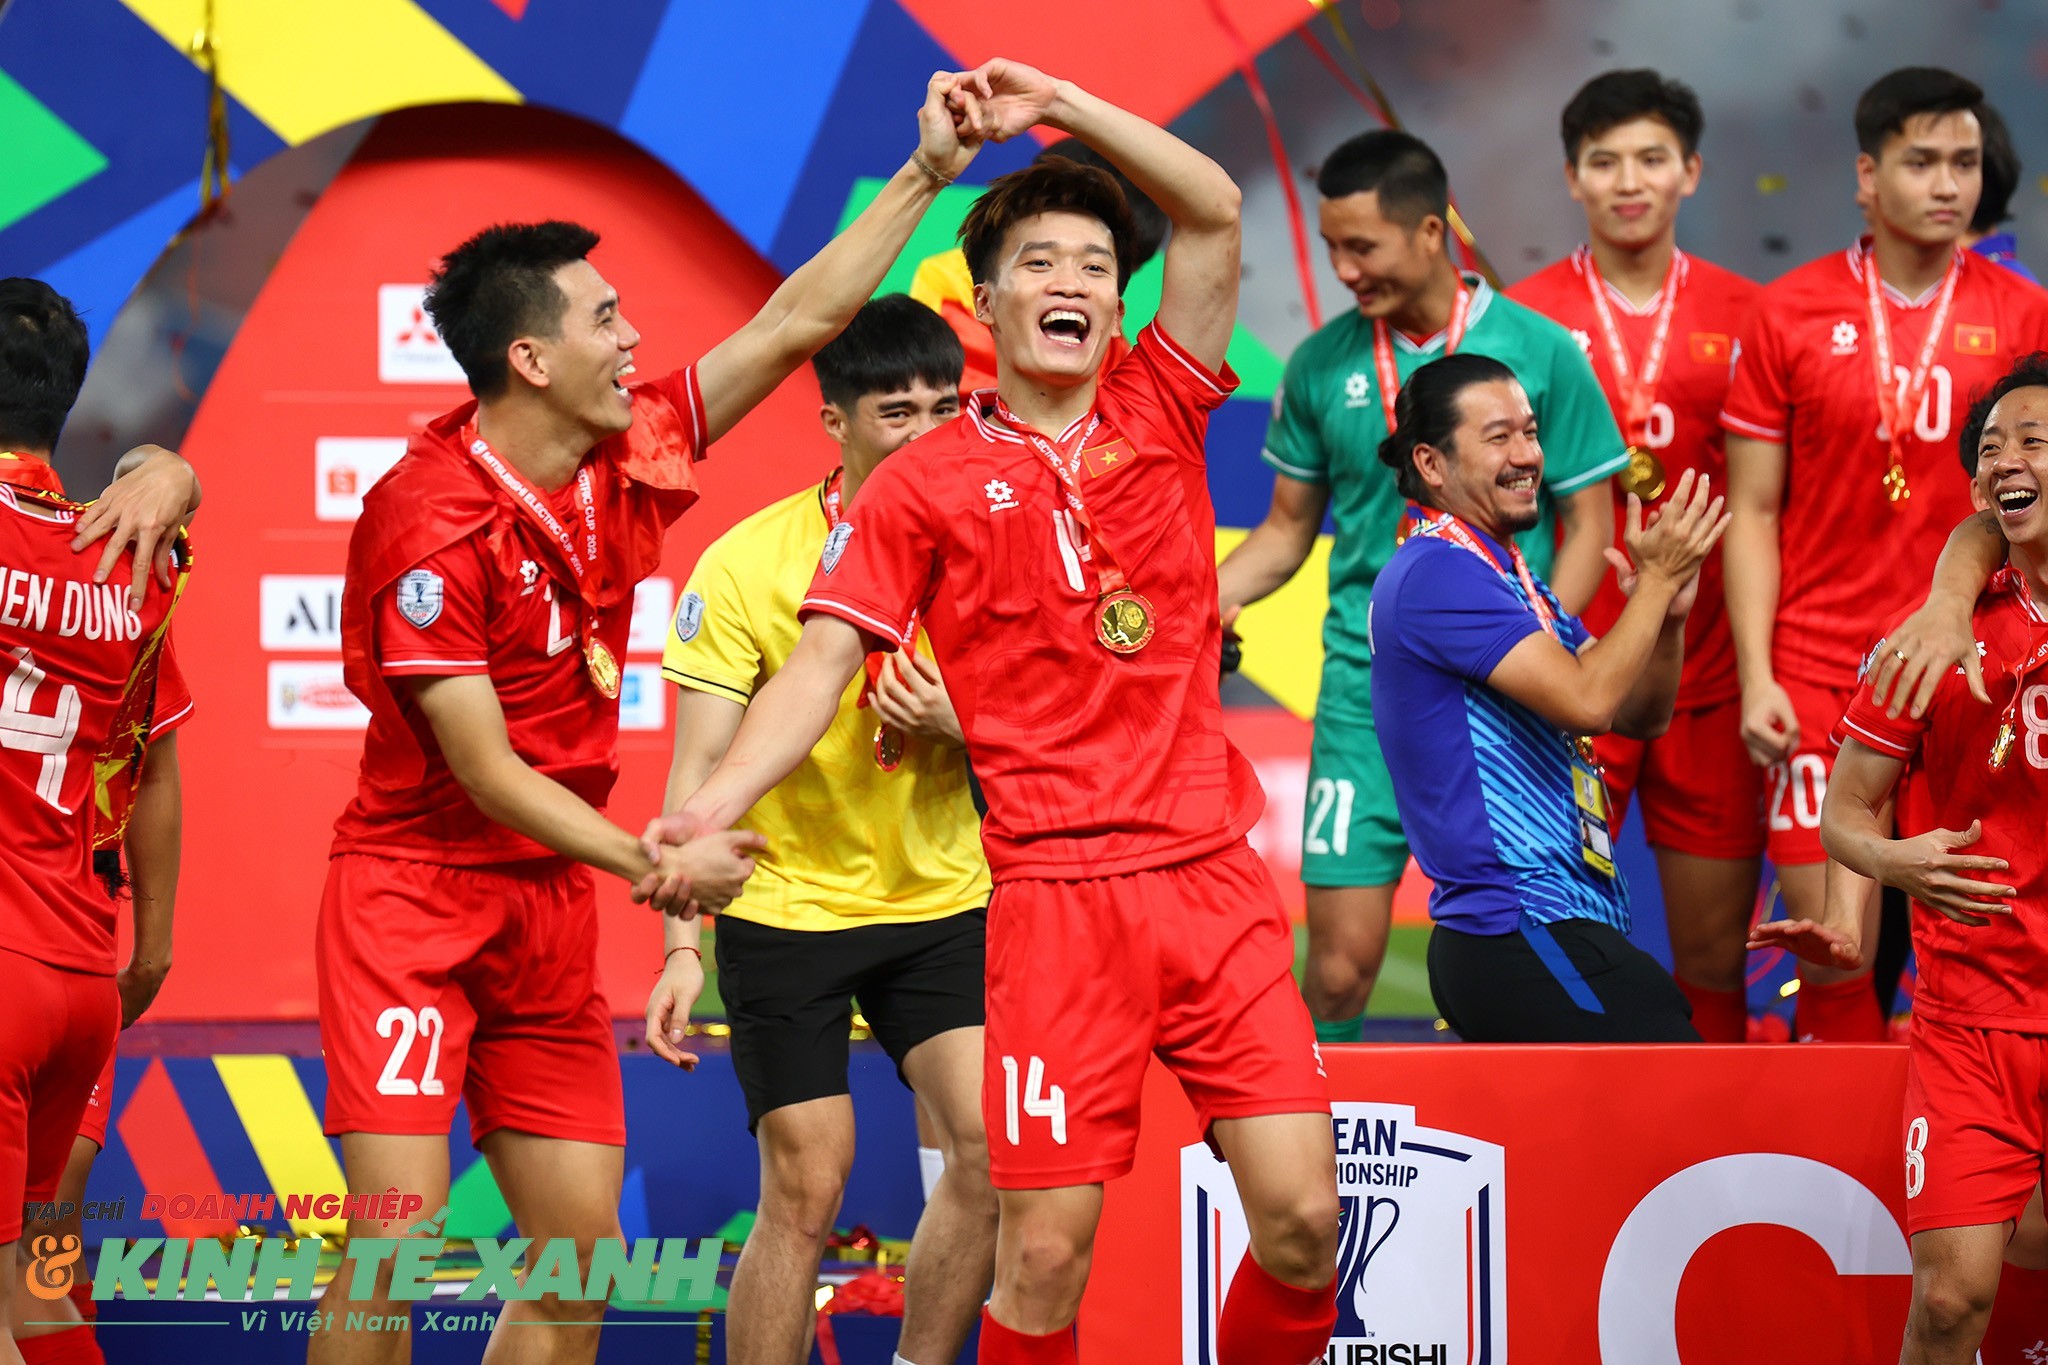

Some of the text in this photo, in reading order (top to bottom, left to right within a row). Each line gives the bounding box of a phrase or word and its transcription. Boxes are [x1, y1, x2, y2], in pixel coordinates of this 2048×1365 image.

[481, 451, 529, 497] MITSUBISHI
[523, 492, 563, 535] ELECTRIC
[559, 532, 574, 553] CUP
[585, 506, 596, 531] CUP
[587, 534, 597, 561] 2024
[58, 580, 142, 642] DUNG
[0, 647, 83, 816] 4
[2021, 684, 2048, 770] 8
[1304, 778, 1356, 856] 21
[1768, 754, 1828, 832] 20
[375, 1006, 445, 1096] 22
[1001, 1055, 1067, 1145] 14
[1332, 1118, 1397, 1156] EAN
[1335, 1162, 1419, 1188] IONSHIP
[1905, 1116, 1929, 1199] 8
